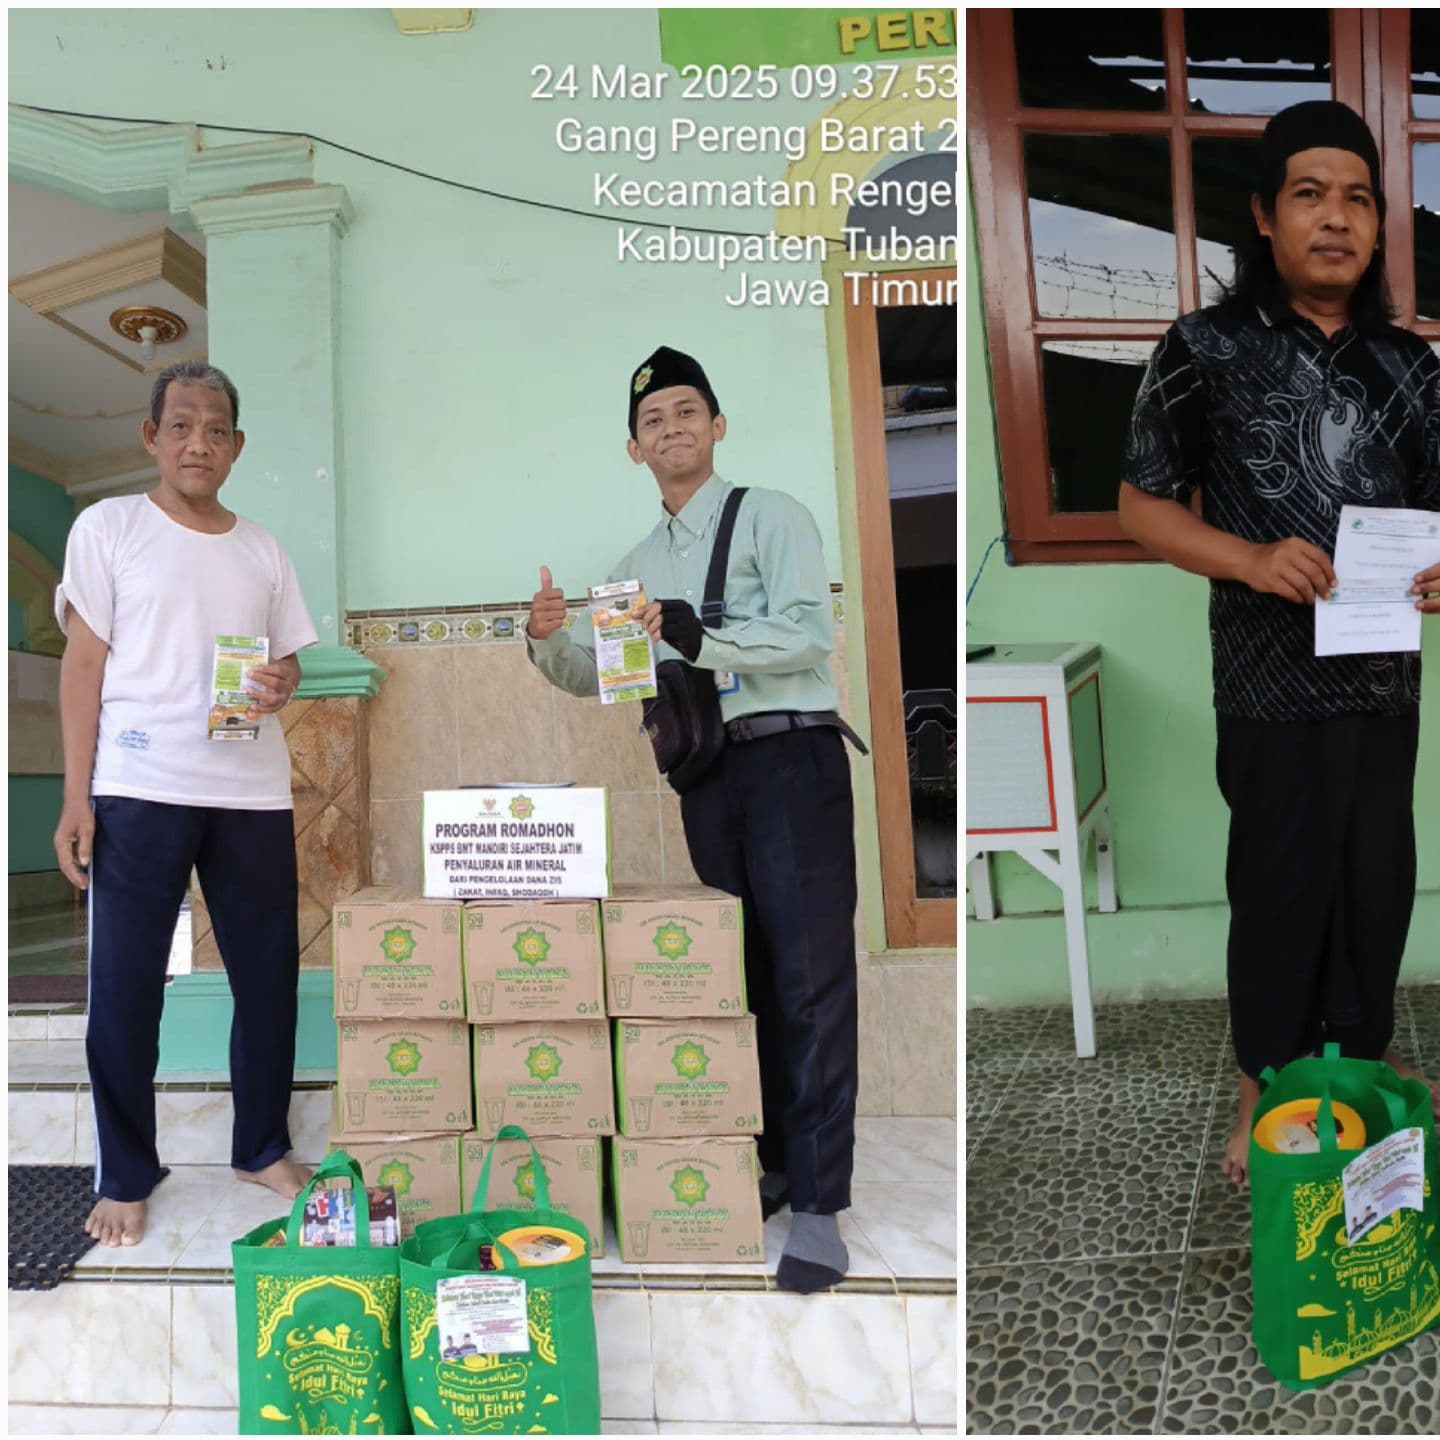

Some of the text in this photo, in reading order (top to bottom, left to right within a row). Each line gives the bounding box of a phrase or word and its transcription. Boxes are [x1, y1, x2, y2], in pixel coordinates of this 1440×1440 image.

[839, 10, 957, 54] PER
[436, 823, 575, 838] PROGRAM ROMADHON
[444, 859, 567, 871] PENYALURAN AIR MINERAL
[452, 1401, 515, 1417] Idul Fitri
